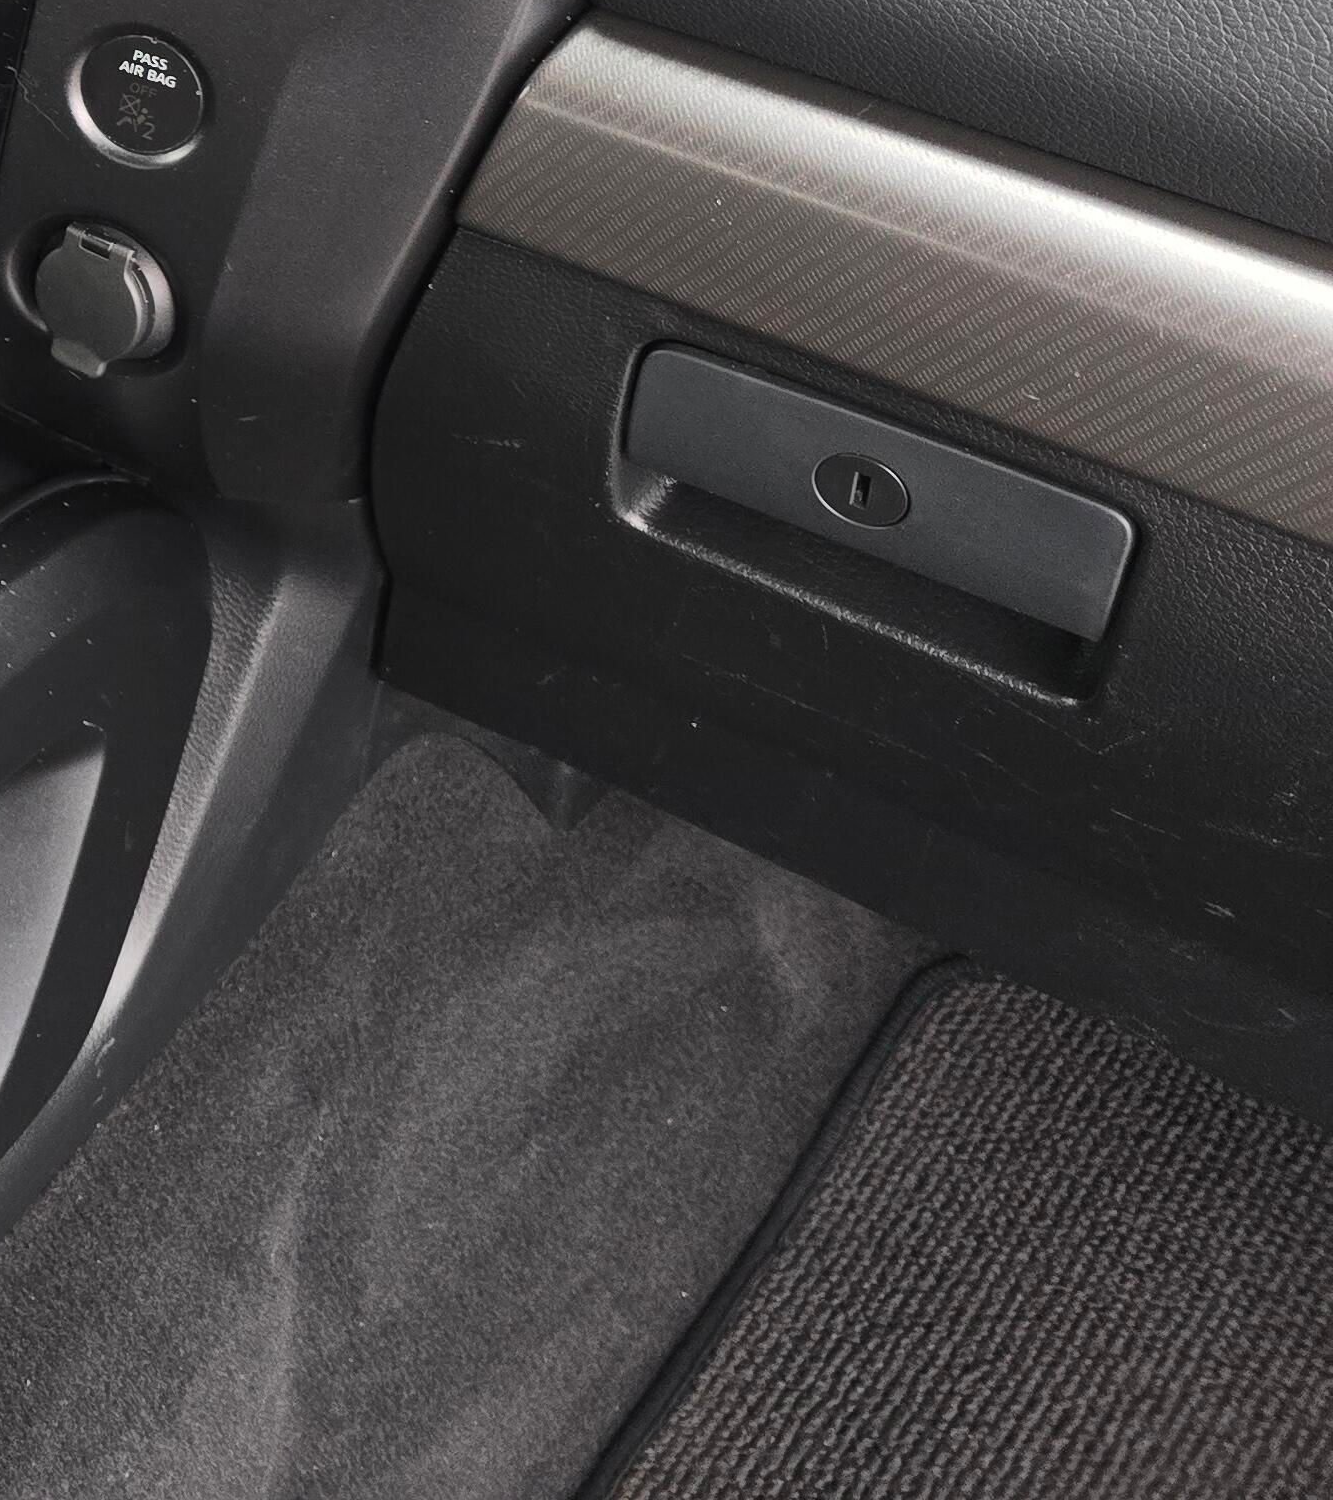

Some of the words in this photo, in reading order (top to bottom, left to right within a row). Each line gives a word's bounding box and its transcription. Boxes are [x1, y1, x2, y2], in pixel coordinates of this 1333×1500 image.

[133, 49, 169, 71] PASS
[118, 60, 144, 77] AIR
[147, 69, 177, 89] BAG
[129, 82, 158, 98] OFF
